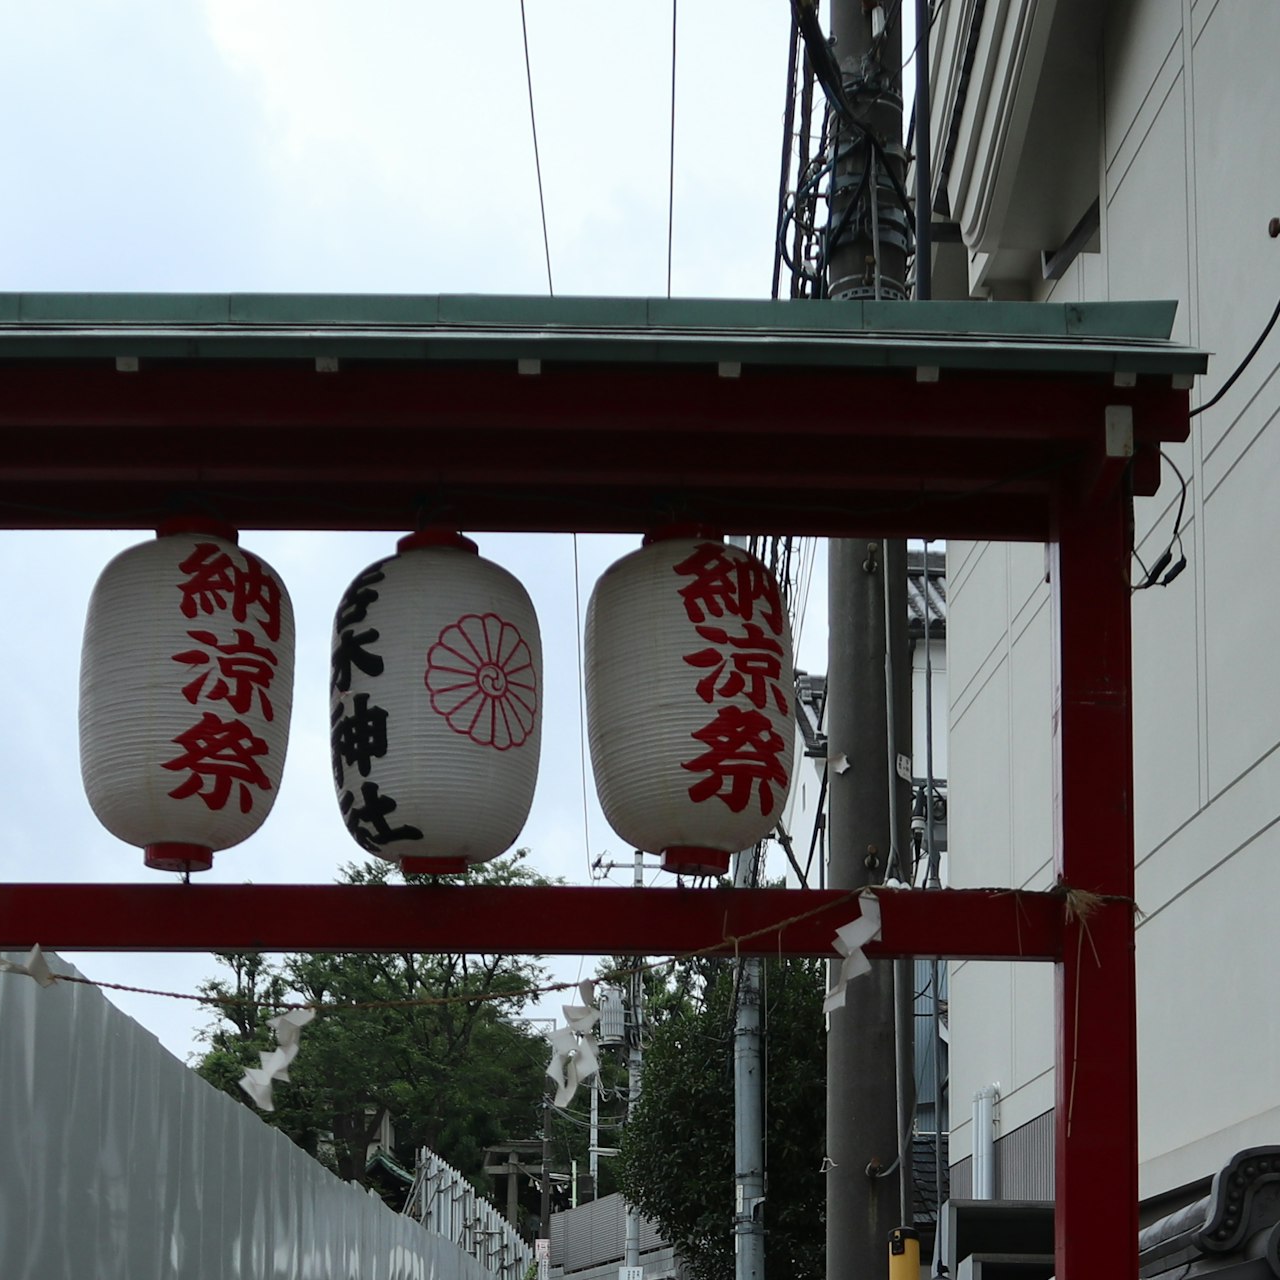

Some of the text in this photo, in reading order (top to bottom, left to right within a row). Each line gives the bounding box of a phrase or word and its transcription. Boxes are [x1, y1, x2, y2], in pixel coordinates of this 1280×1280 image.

[161, 542, 281, 815] 納涼祭
[673, 542, 789, 816] 納涼祭
